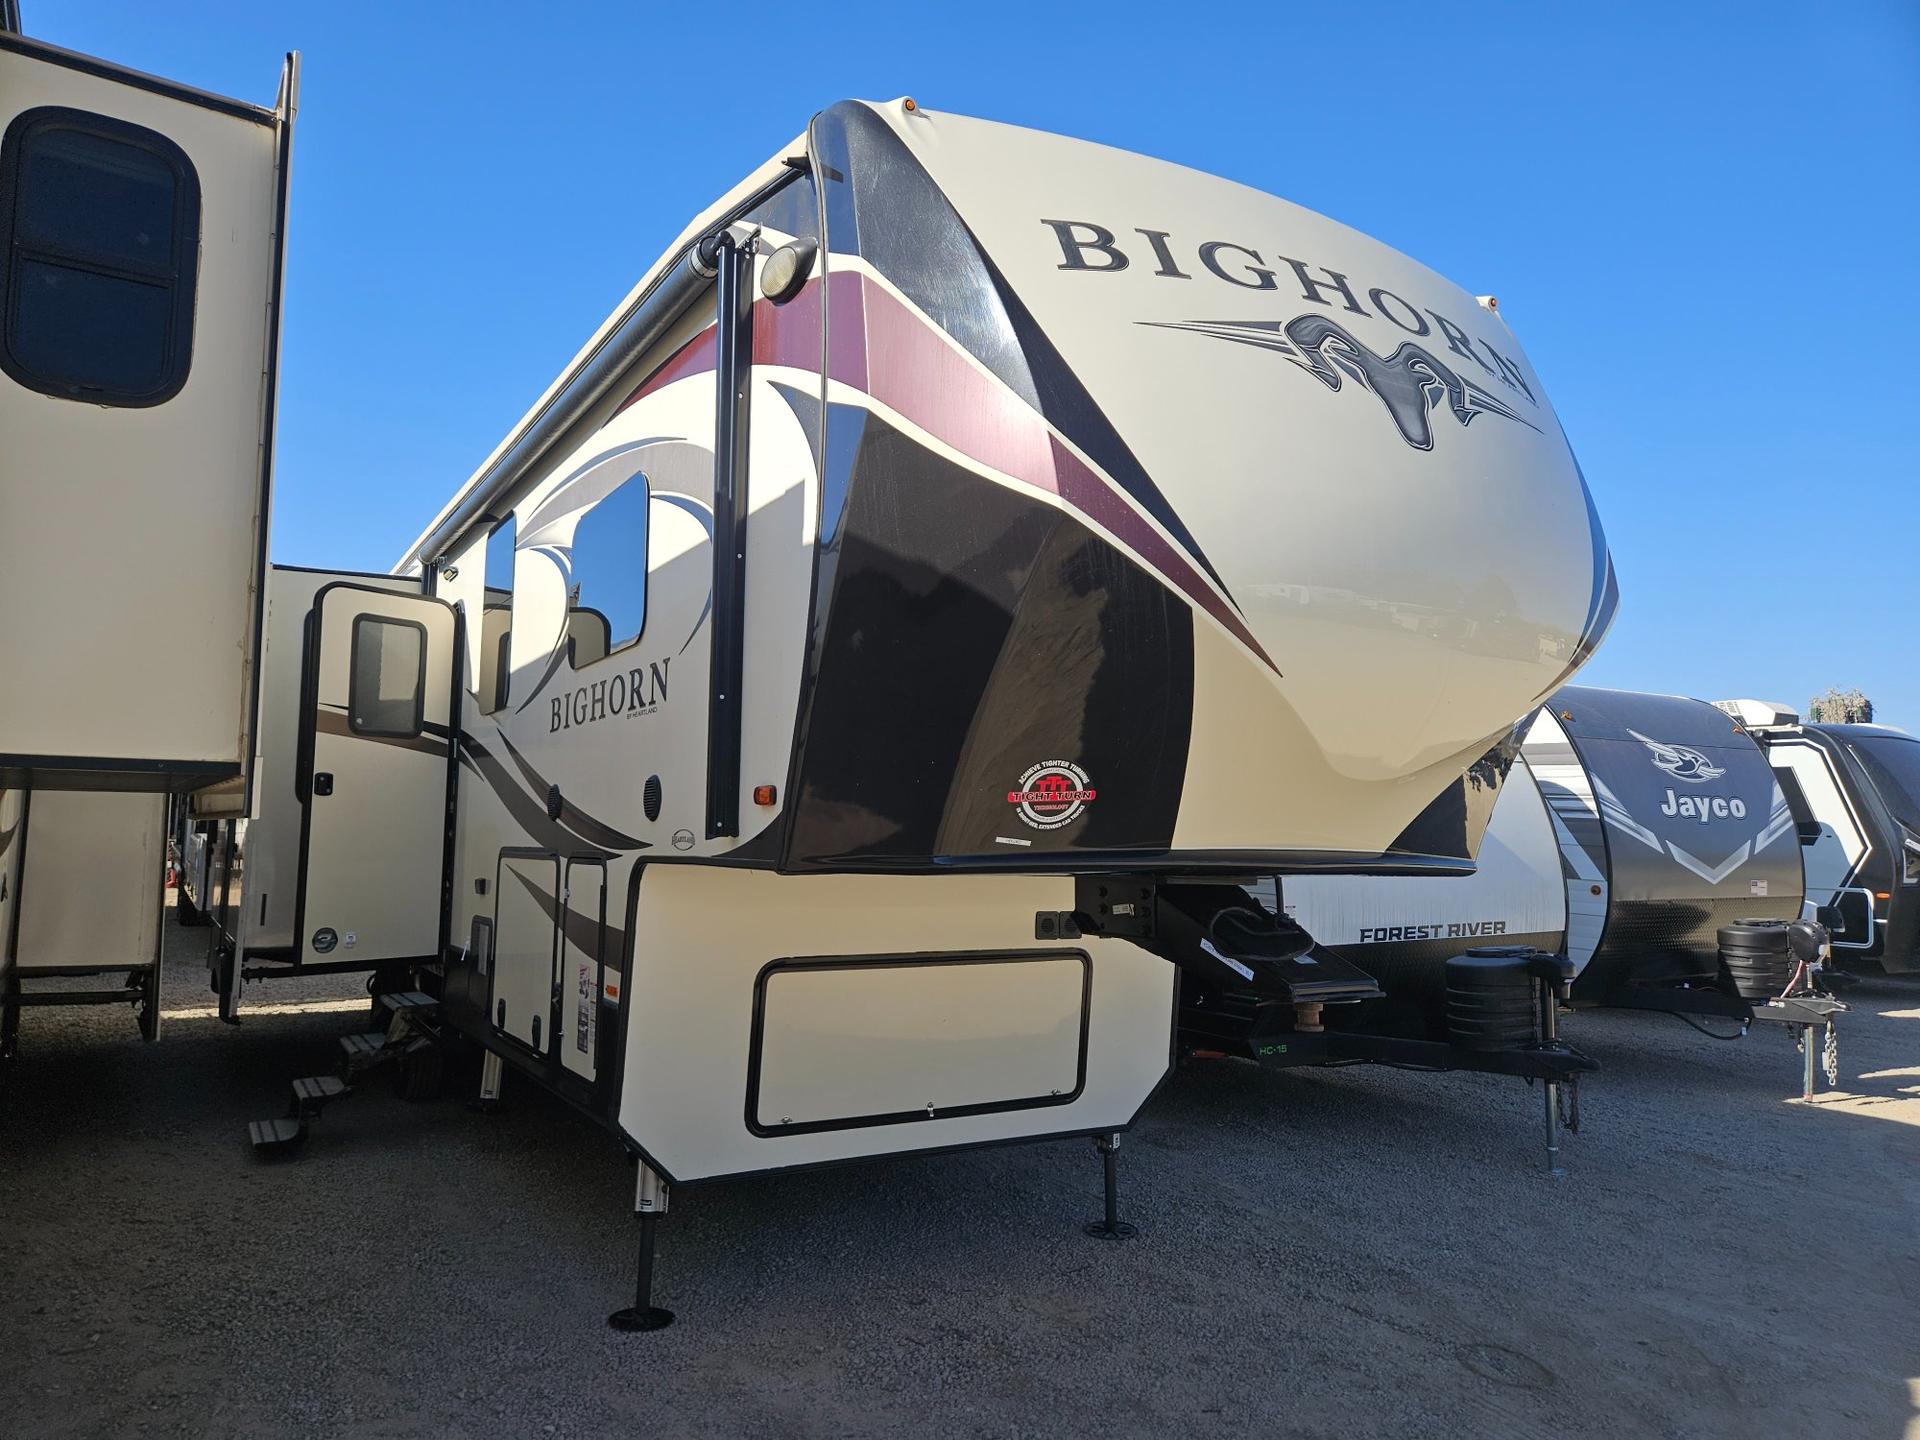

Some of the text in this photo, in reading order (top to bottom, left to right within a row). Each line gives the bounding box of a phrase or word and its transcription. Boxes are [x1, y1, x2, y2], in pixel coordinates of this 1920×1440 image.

[1041, 219, 1536, 404] BIGHORN
[549, 657, 670, 733] BIGHORN
[1041, 760, 1069, 768] TIGHTER
[1013, 790, 1092, 802] TIGHT TURN
[1660, 787, 1747, 825] Jayco
[1360, 920, 1506, 942] FOREST RIVER
